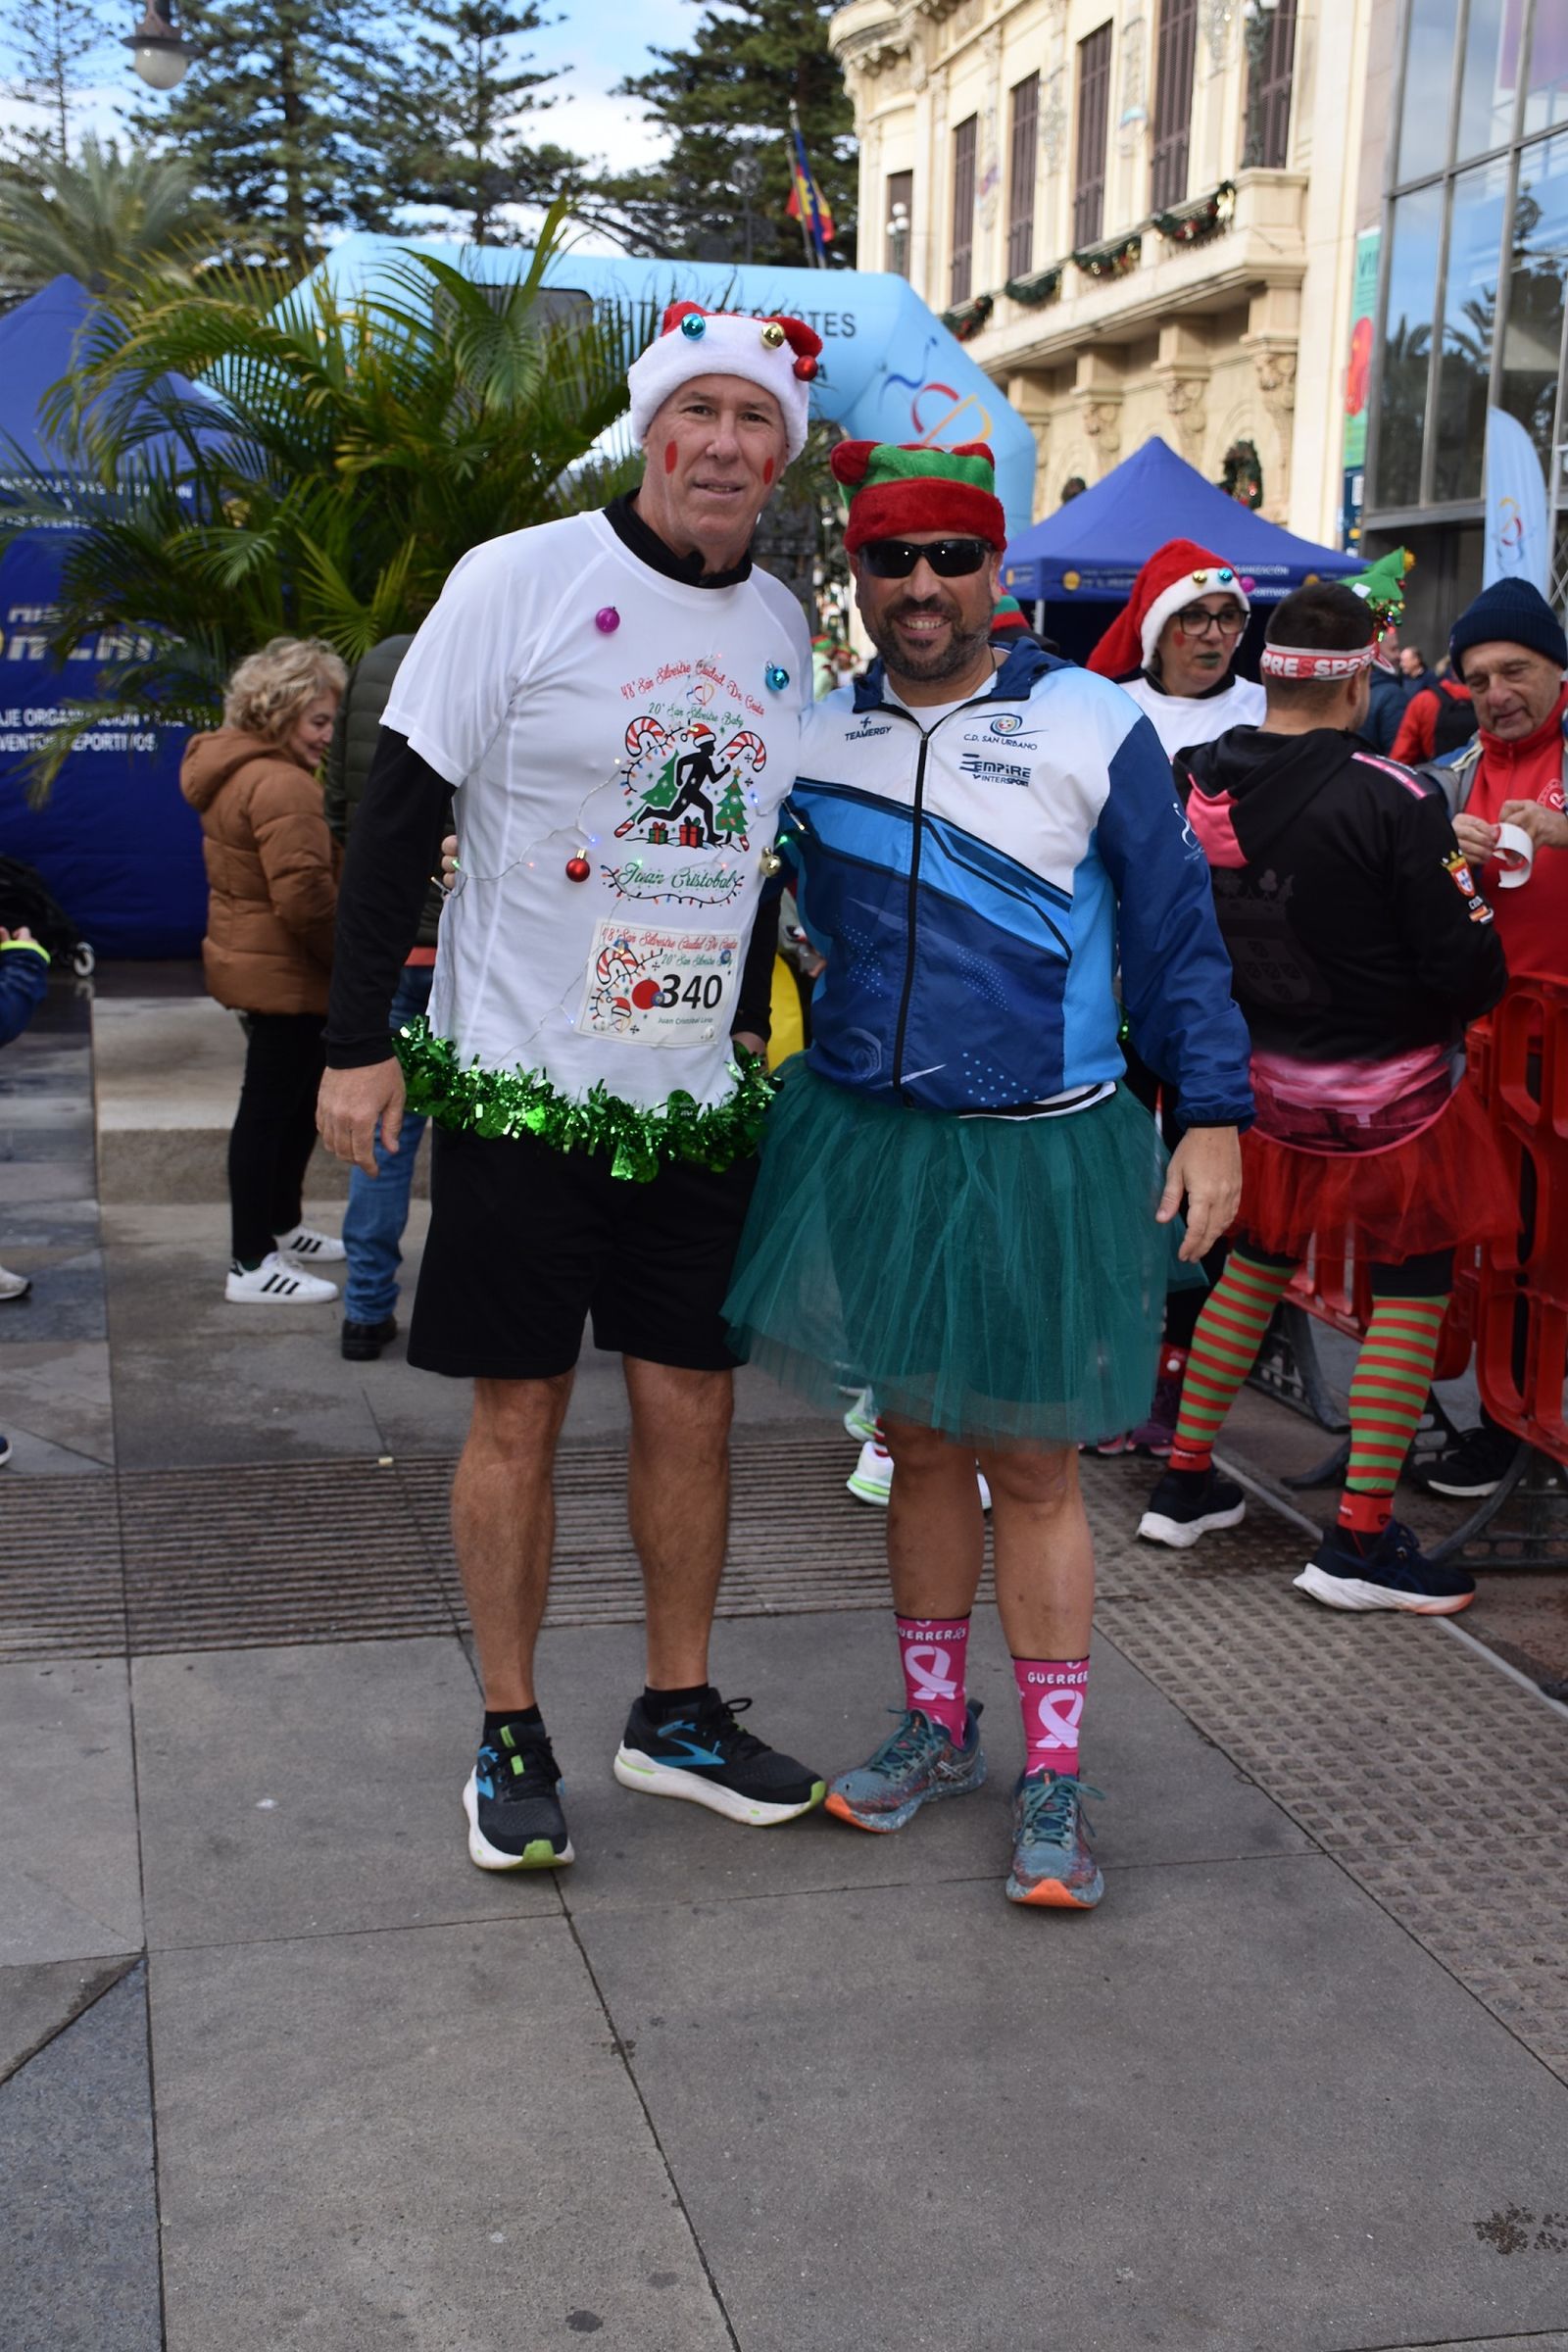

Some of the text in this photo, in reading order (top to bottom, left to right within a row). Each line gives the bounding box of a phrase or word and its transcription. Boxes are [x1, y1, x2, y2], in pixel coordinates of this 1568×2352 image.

[845, 726, 893, 741] TEAMERGY
[963, 734, 1038, 751] C.D. SAN URBANO
[617, 862, 664, 885] Juan
[660, 973, 723, 1009] 340
